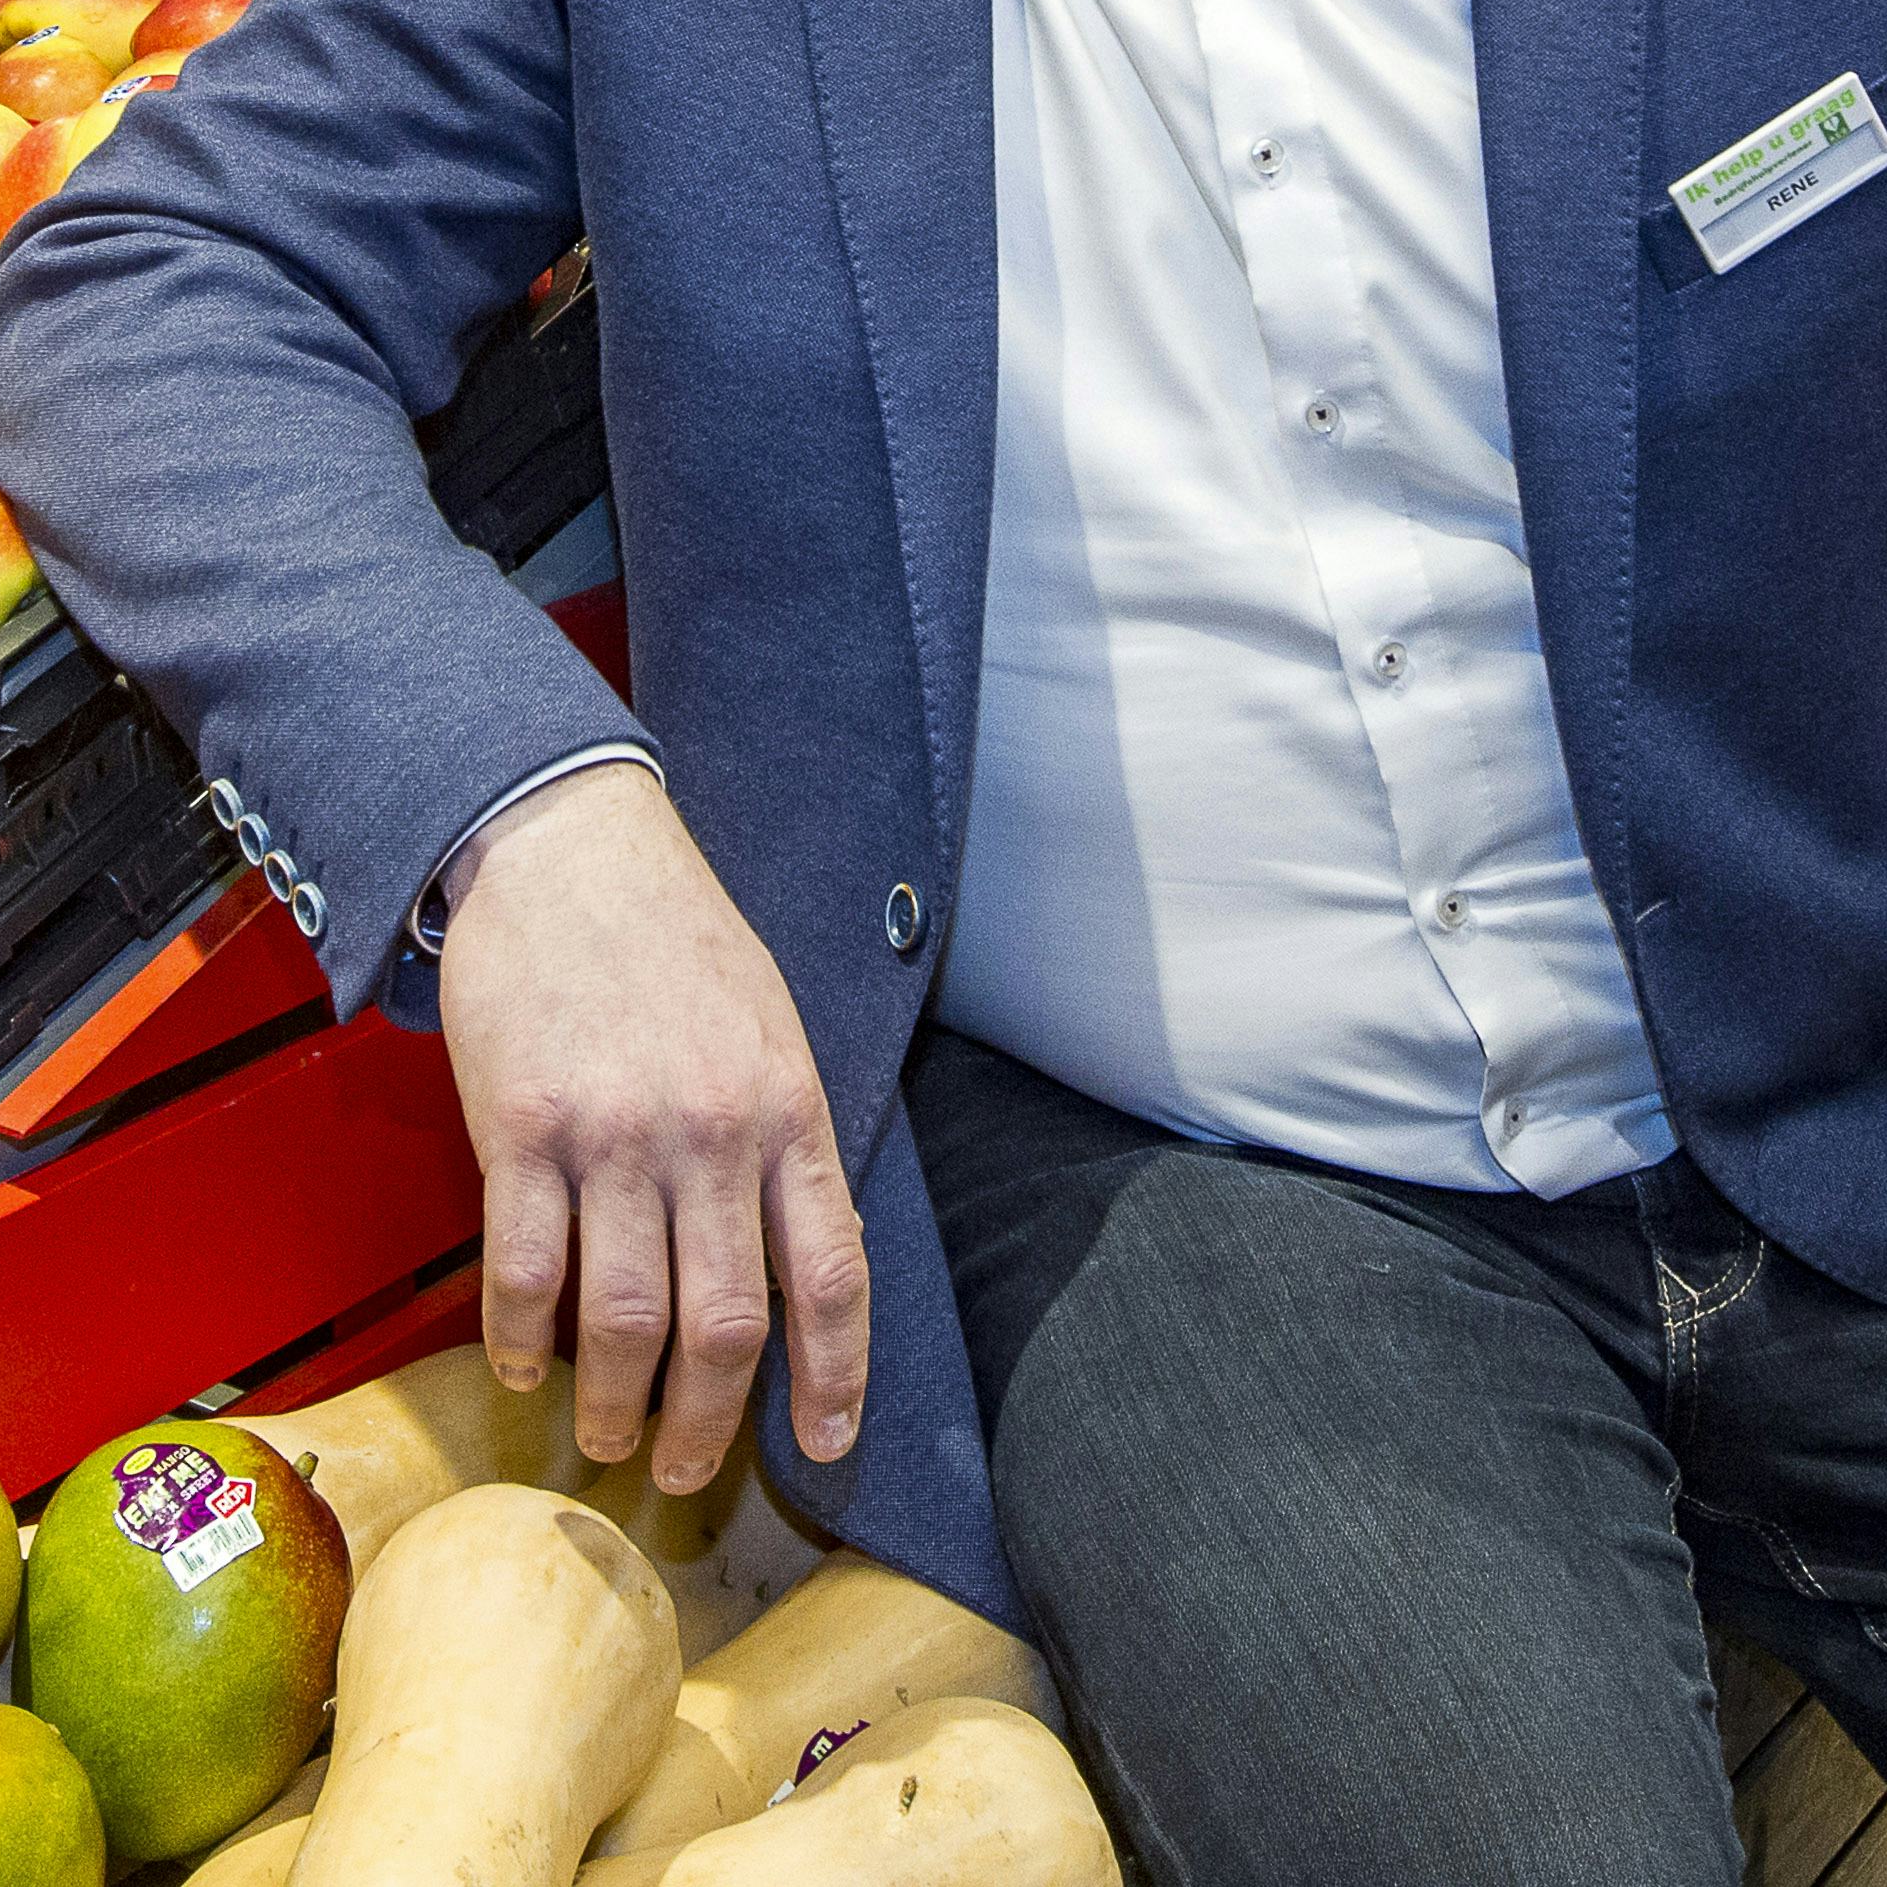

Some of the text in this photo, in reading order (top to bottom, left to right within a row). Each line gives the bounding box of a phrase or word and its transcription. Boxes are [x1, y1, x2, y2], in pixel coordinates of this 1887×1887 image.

[1684, 88, 1856, 204] Ik help u graag
[1767, 171, 1819, 211] RENE
[153, 1446, 191, 1475] MANGO
[122, 1451, 211, 1530] EAT ME
[180, 1469, 218, 1502] SWEET
